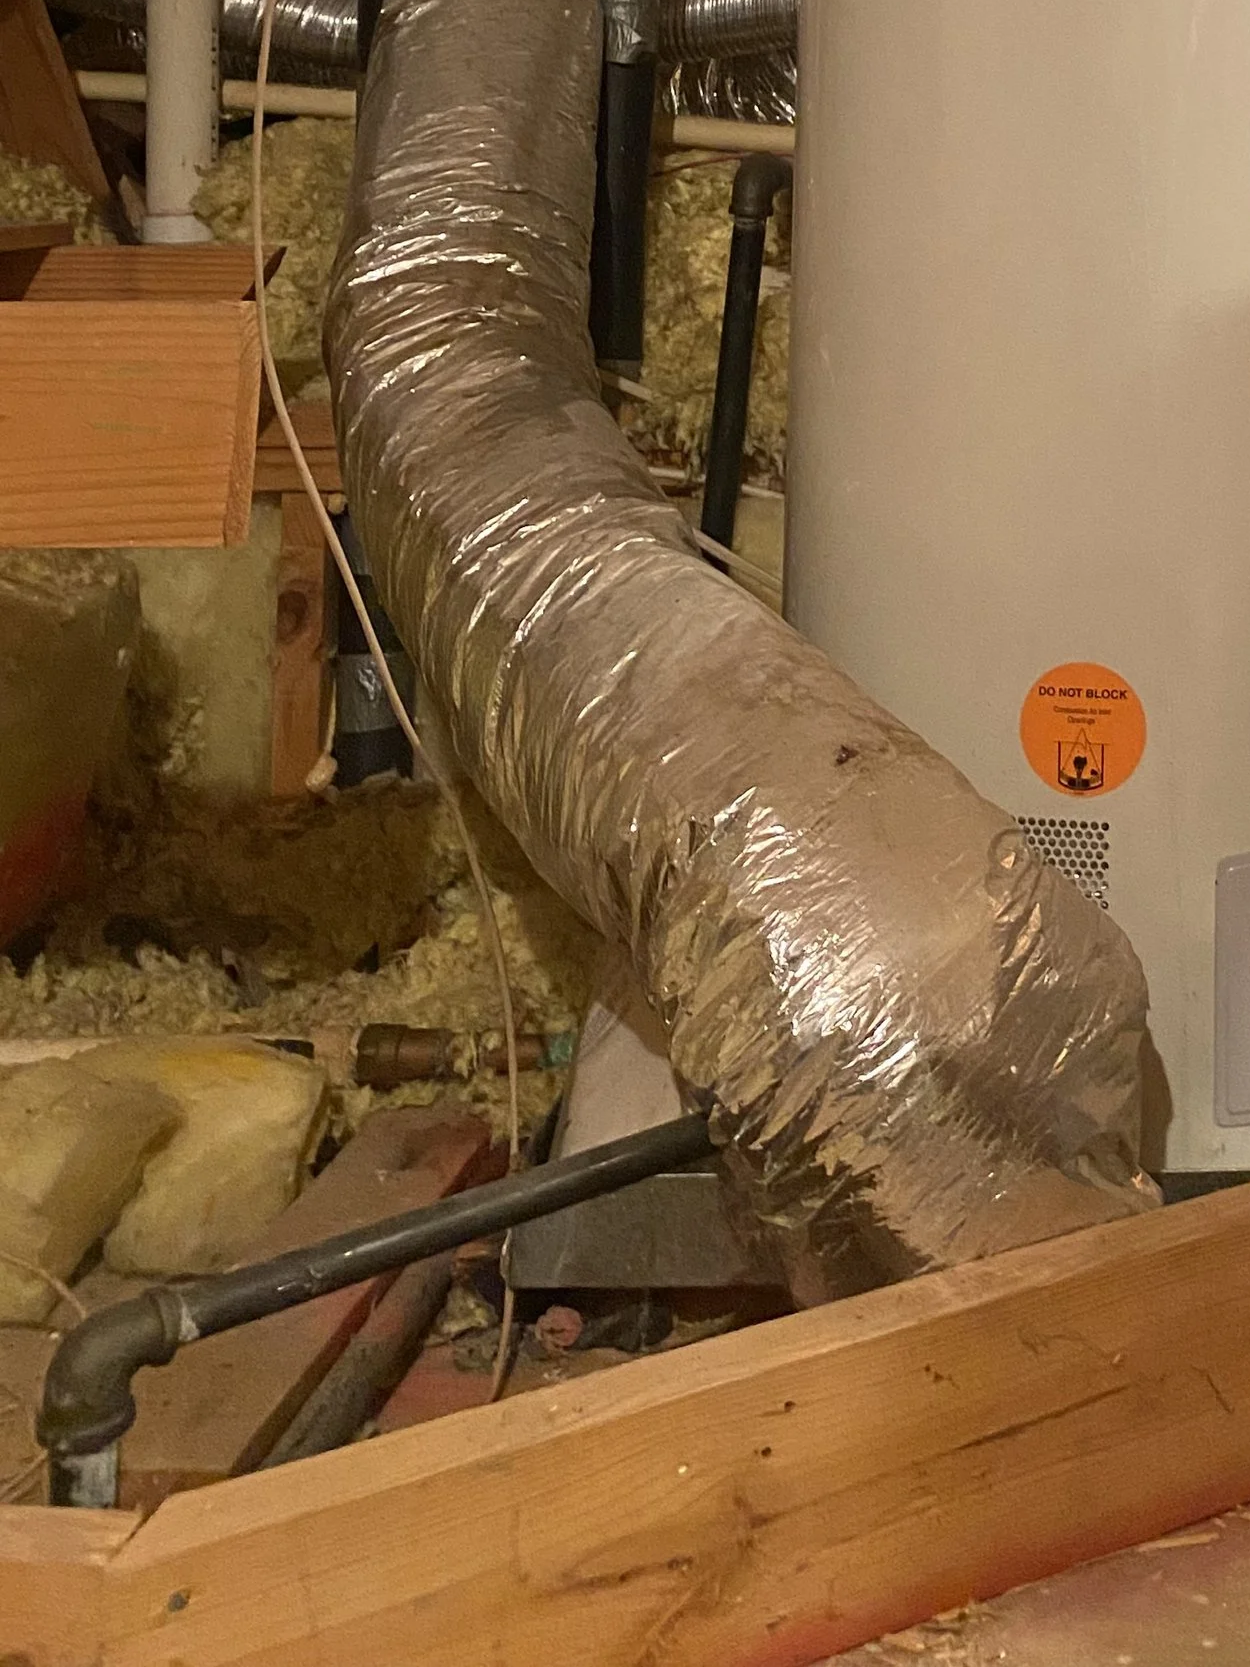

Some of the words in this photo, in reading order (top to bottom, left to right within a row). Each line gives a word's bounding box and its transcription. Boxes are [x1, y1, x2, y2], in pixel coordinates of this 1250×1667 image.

[1039, 686, 1055, 696] DO
[1059, 688, 1083, 698] NOT
[1086, 689, 1128, 700] BLOCK
